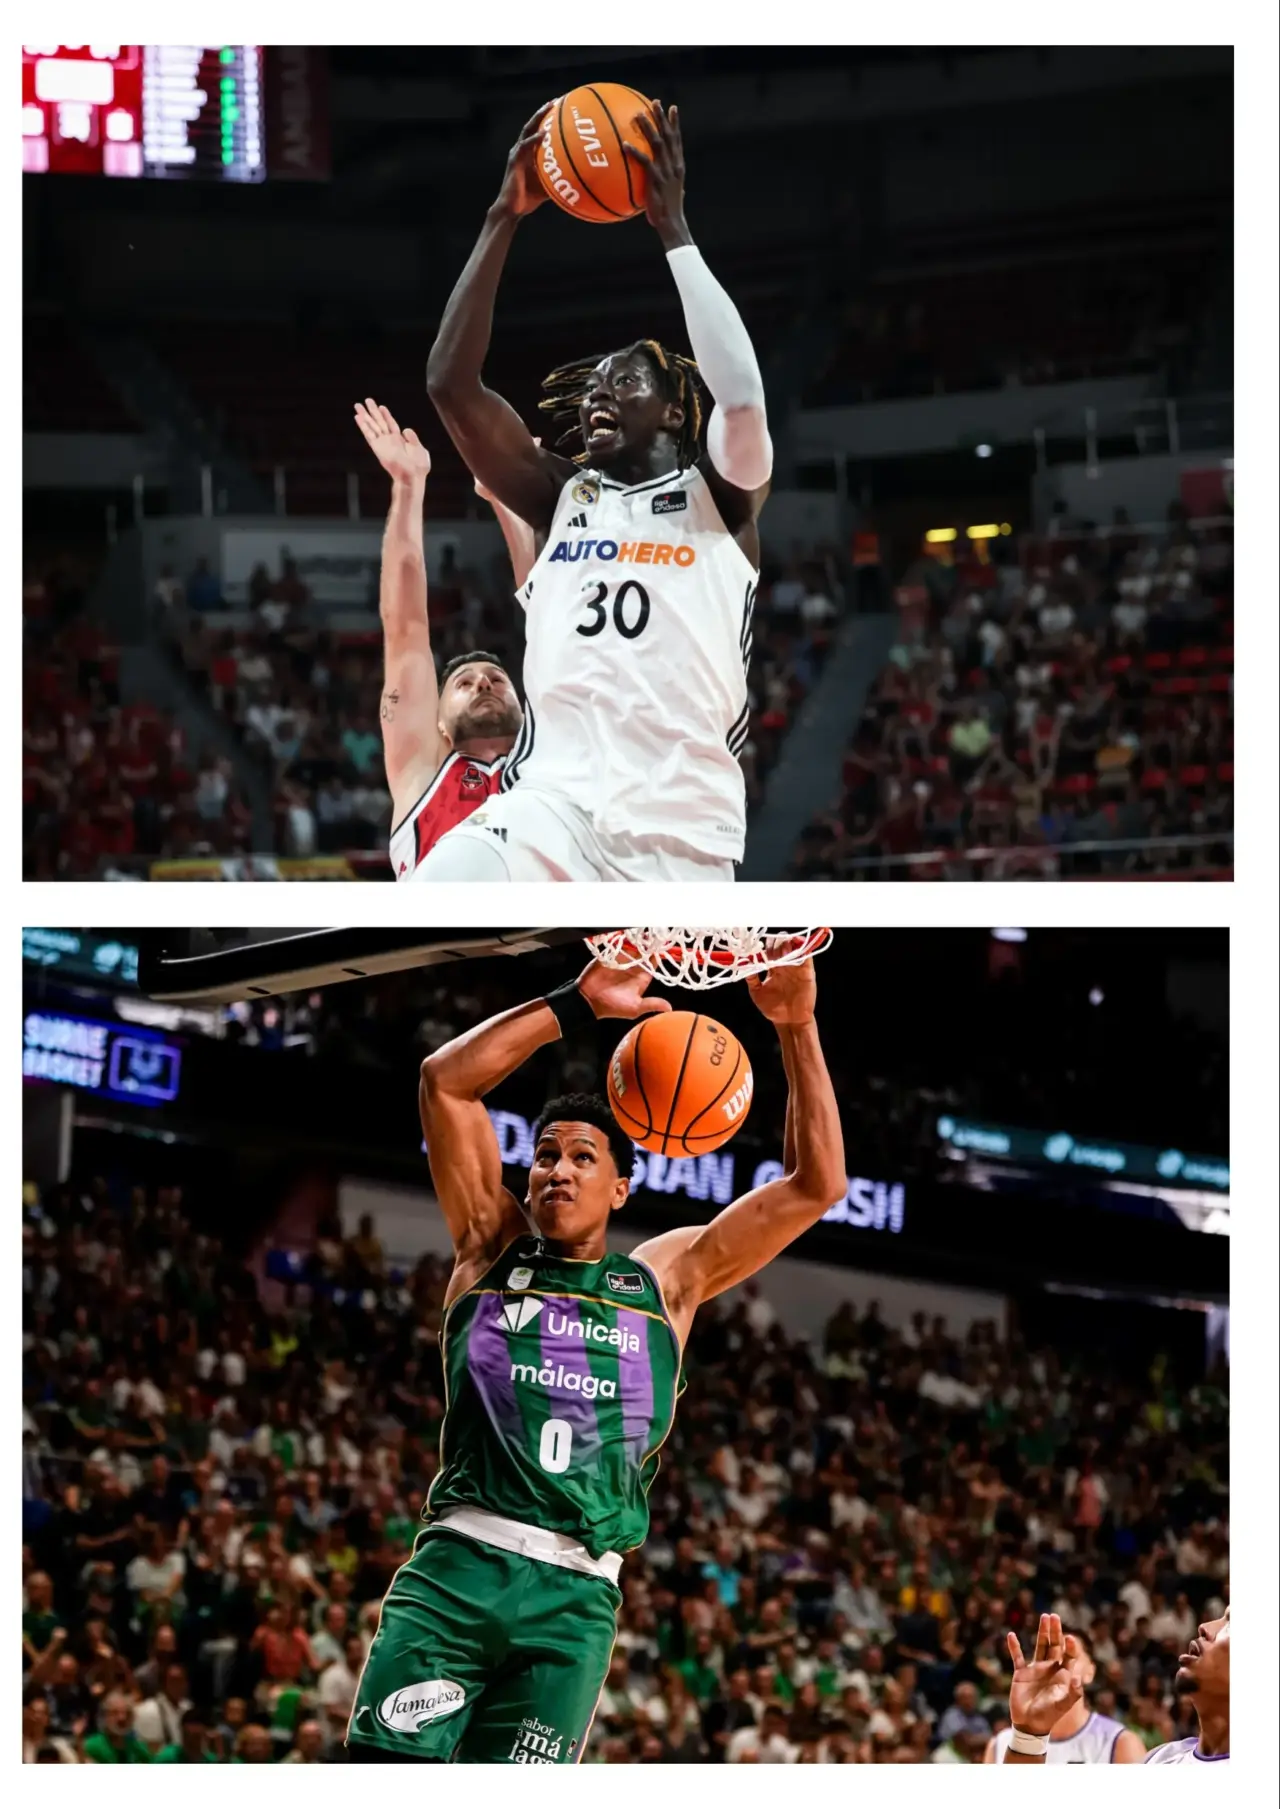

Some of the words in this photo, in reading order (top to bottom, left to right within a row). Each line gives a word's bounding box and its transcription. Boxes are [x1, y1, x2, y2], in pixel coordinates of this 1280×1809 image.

[575, 118, 609, 168] EVO
[548, 540, 696, 568] AUTOHERO
[575, 580, 651, 639] 30
[709, 1035, 728, 1067] acb
[547, 1313, 641, 1354] Unicaja
[539, 1418, 573, 1474] 0
[521, 1717, 555, 1737] sabor
[522, 1730, 564, 1759] má
